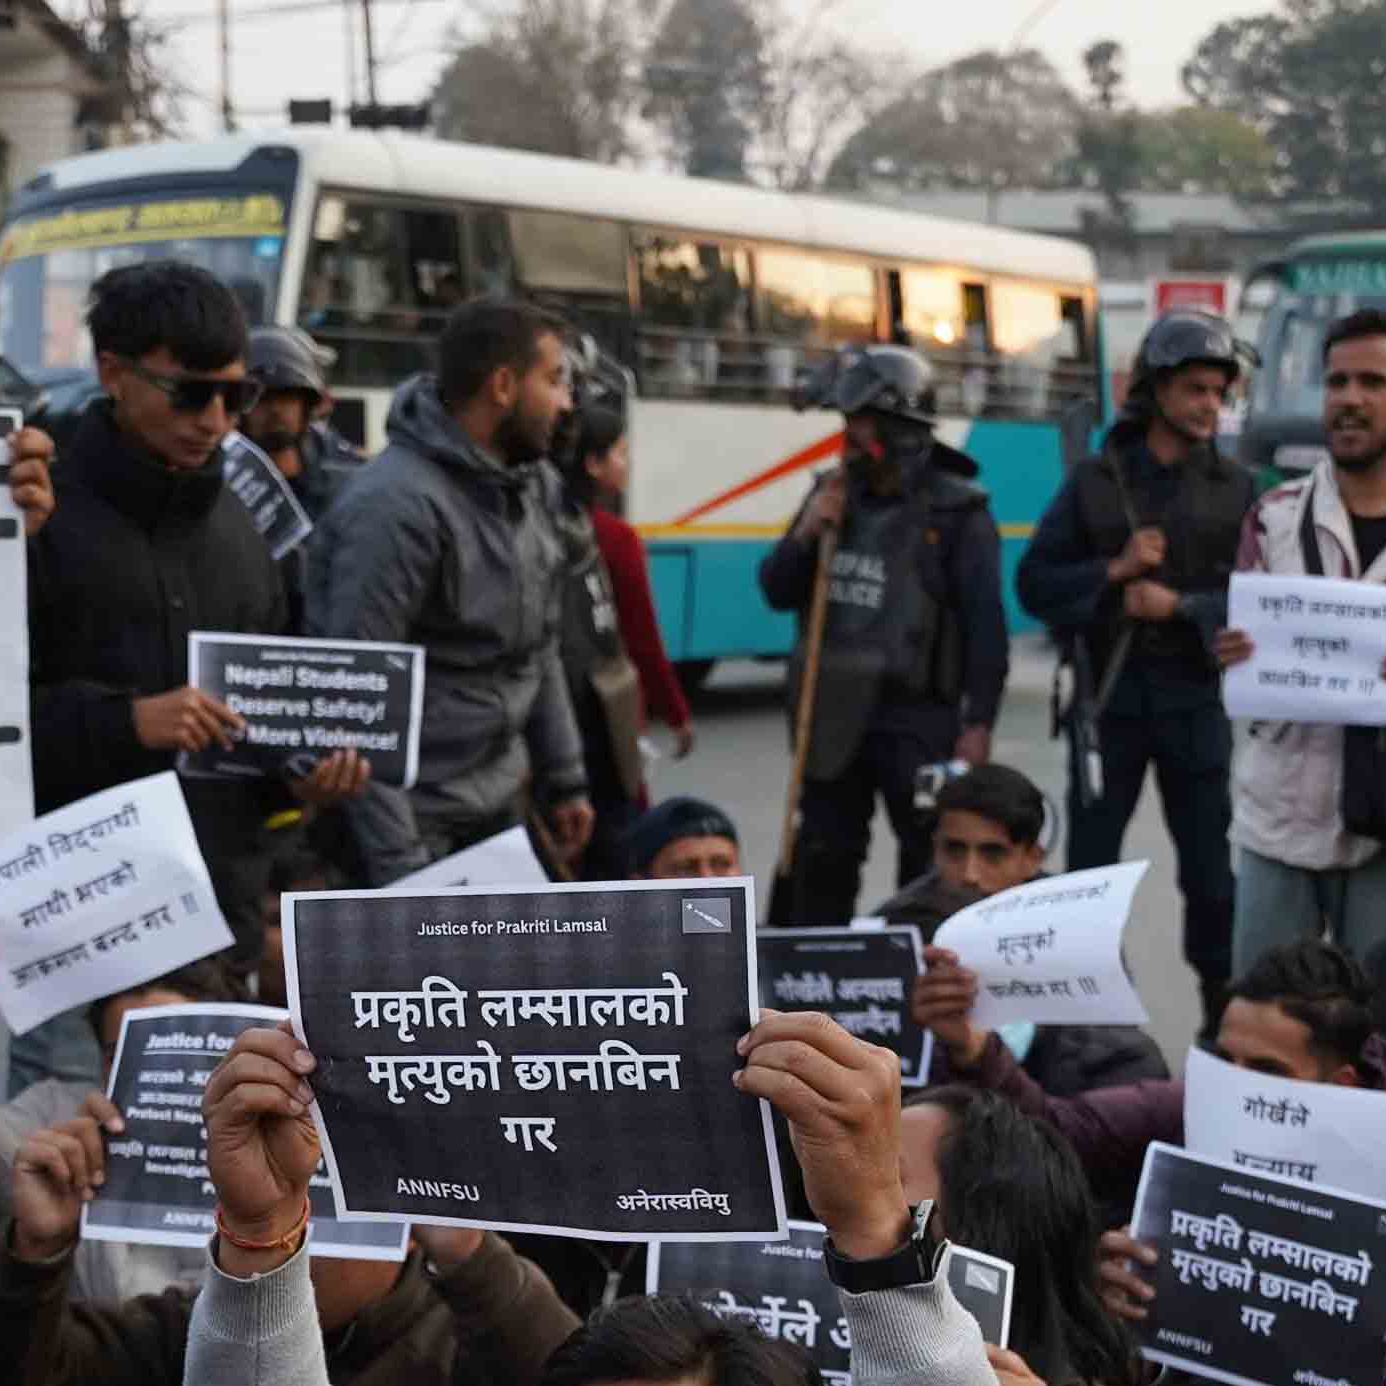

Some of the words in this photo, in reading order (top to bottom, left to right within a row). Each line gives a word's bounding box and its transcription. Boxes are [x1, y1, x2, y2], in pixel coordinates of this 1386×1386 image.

[224, 662, 294, 691] Nepali
[295, 666, 390, 693] Students
[225, 693, 311, 718] Deserve
[138, 904, 177, 932] गर
[417, 920, 469, 937] Justice
[471, 920, 494, 936] for
[496, 918, 550, 936] Prakriti
[553, 917, 608, 935] Lamsal
[351, 976, 469, 1043] प्रकृति
[477, 972, 689, 1029] लम्सालको
[144, 1032, 204, 1051] Justice
[364, 1040, 502, 1104] मृत्युको
[512, 1040, 681, 1092] छानबिन
[499, 1116, 559, 1154] गर
[396, 1178, 481, 1203] ANNFSU
[760, 1244, 804, 1259] Justice
[1171, 1208, 1244, 1251] प्रकृति
[1247, 1227, 1372, 1287] लम्सालको
[1171, 1248, 1255, 1293] मृत्युको
[1259, 1269, 1359, 1322] छानबिन
[1240, 1304, 1277, 1337] गर
[1156, 1327, 1213, 1355] ANNFSU
